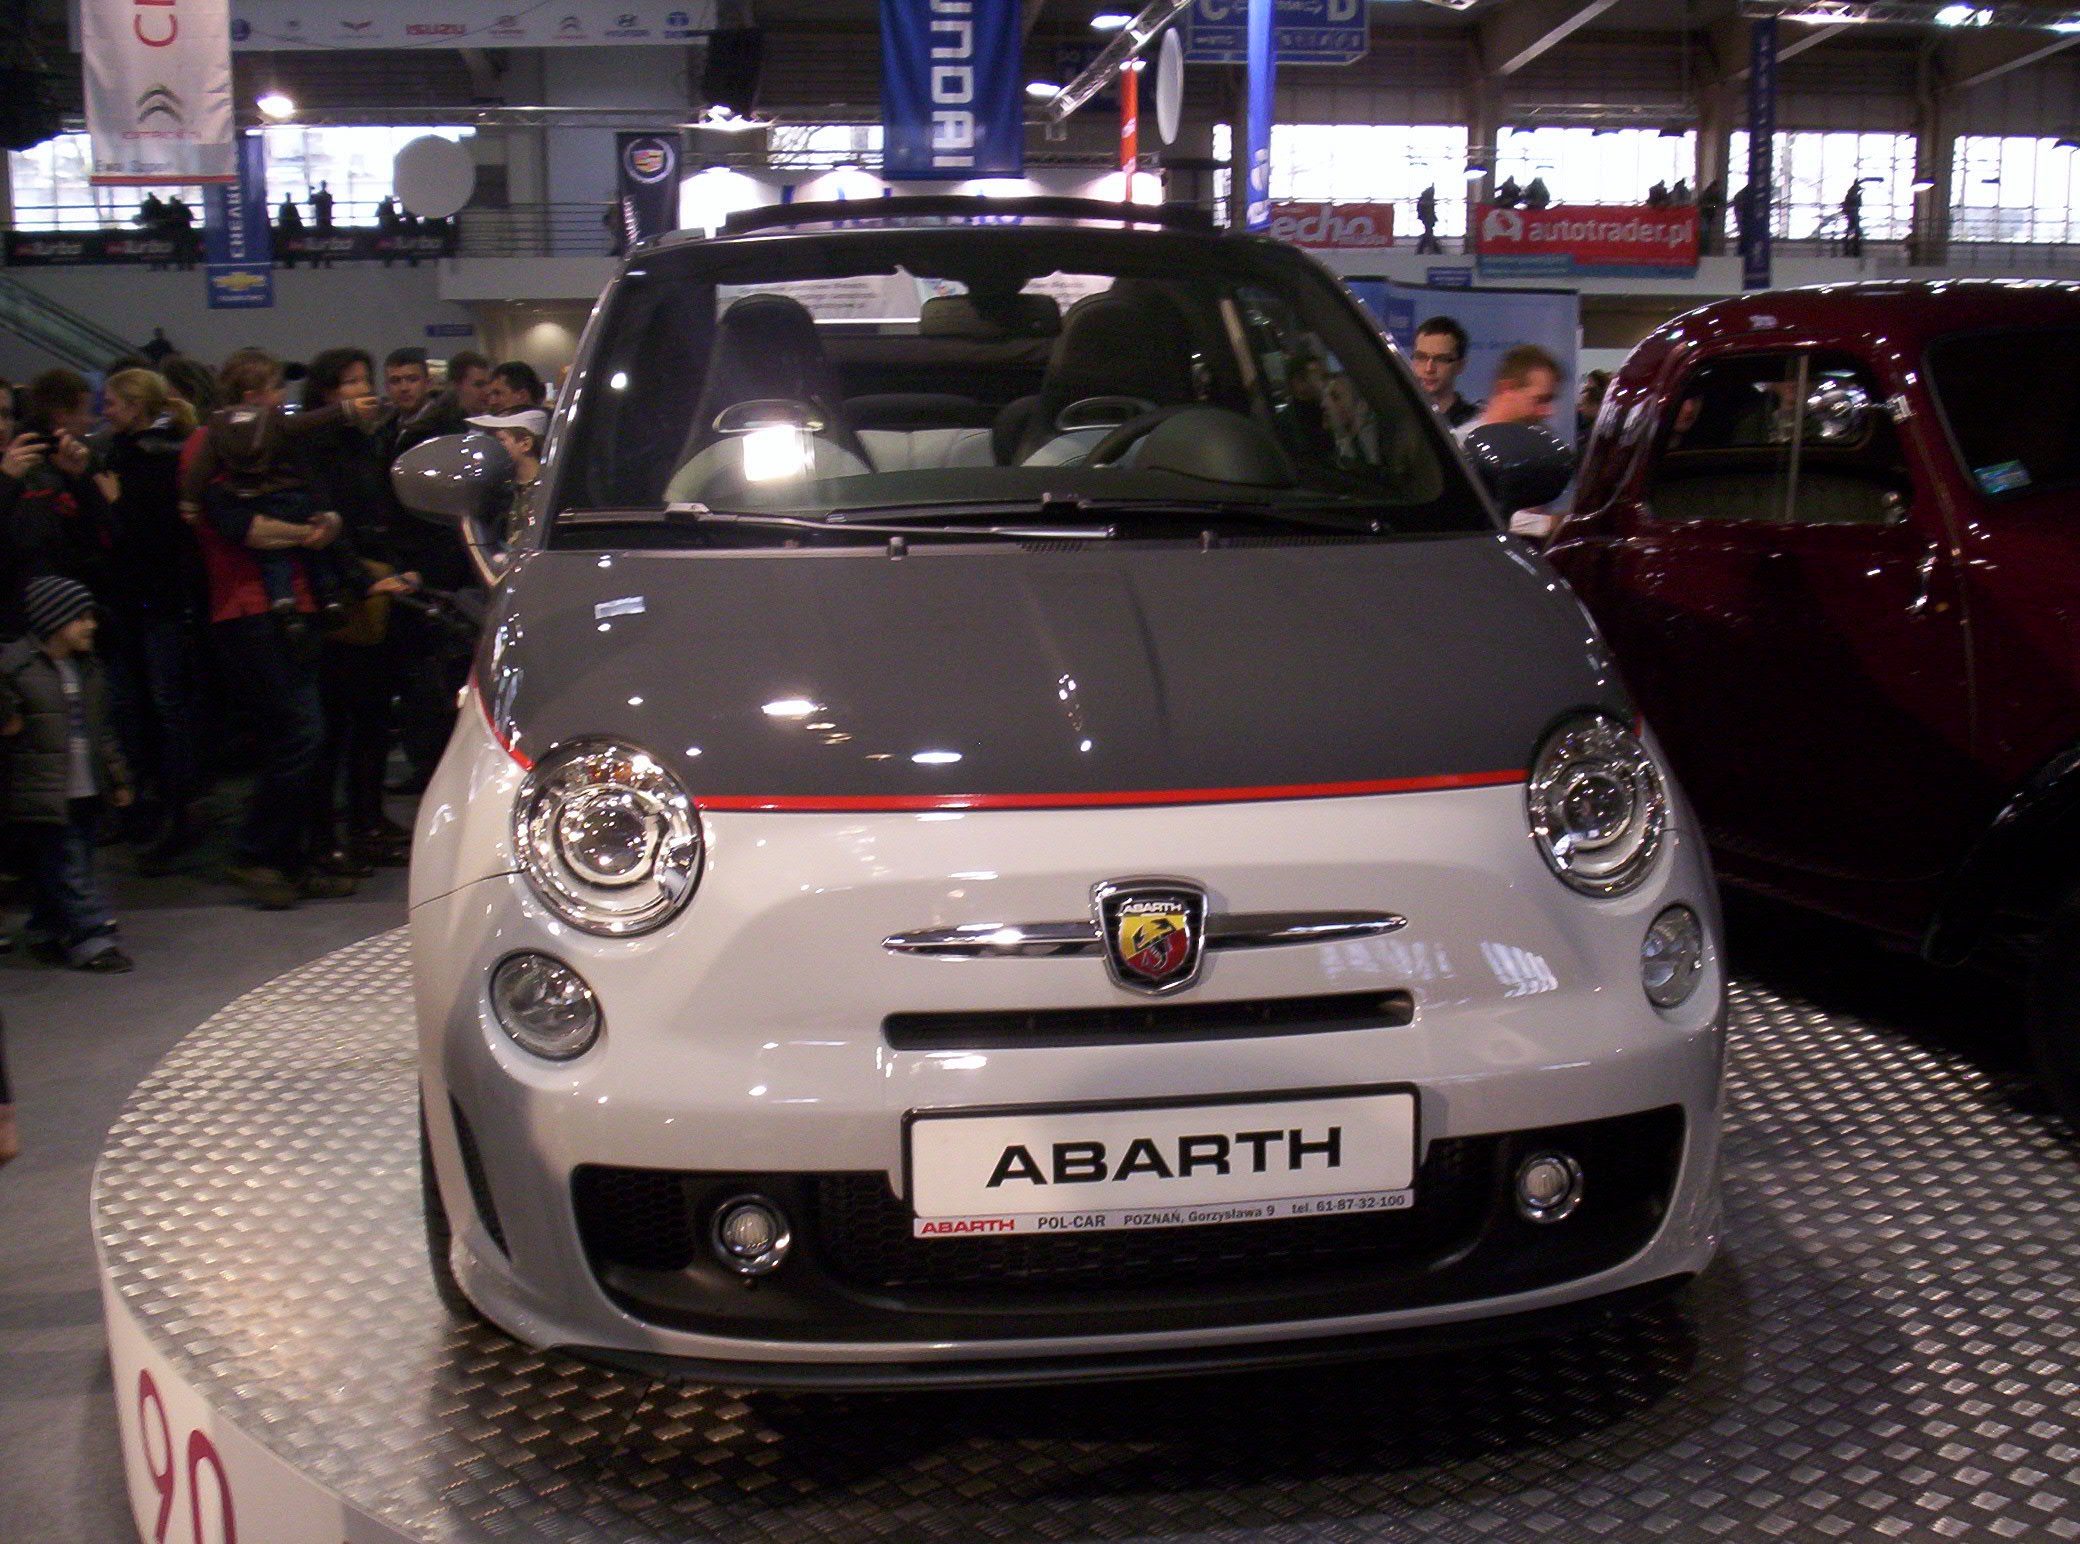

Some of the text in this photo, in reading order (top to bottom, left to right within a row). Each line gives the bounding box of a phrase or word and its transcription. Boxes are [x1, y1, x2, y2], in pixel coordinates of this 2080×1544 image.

[1270, 203, 1375, 241] echo
[1528, 217, 1694, 248] autotrader.pl
[1122, 902, 1182, 914] ABARTH
[986, 1126, 1342, 1188] ABARTH
[921, 1219, 1015, 1234] ABARTH
[1037, 1214, 1106, 1230] POL-CAR
[1266, 1204, 1276, 1217] 9
[1292, 1202, 1311, 1214] tel.
